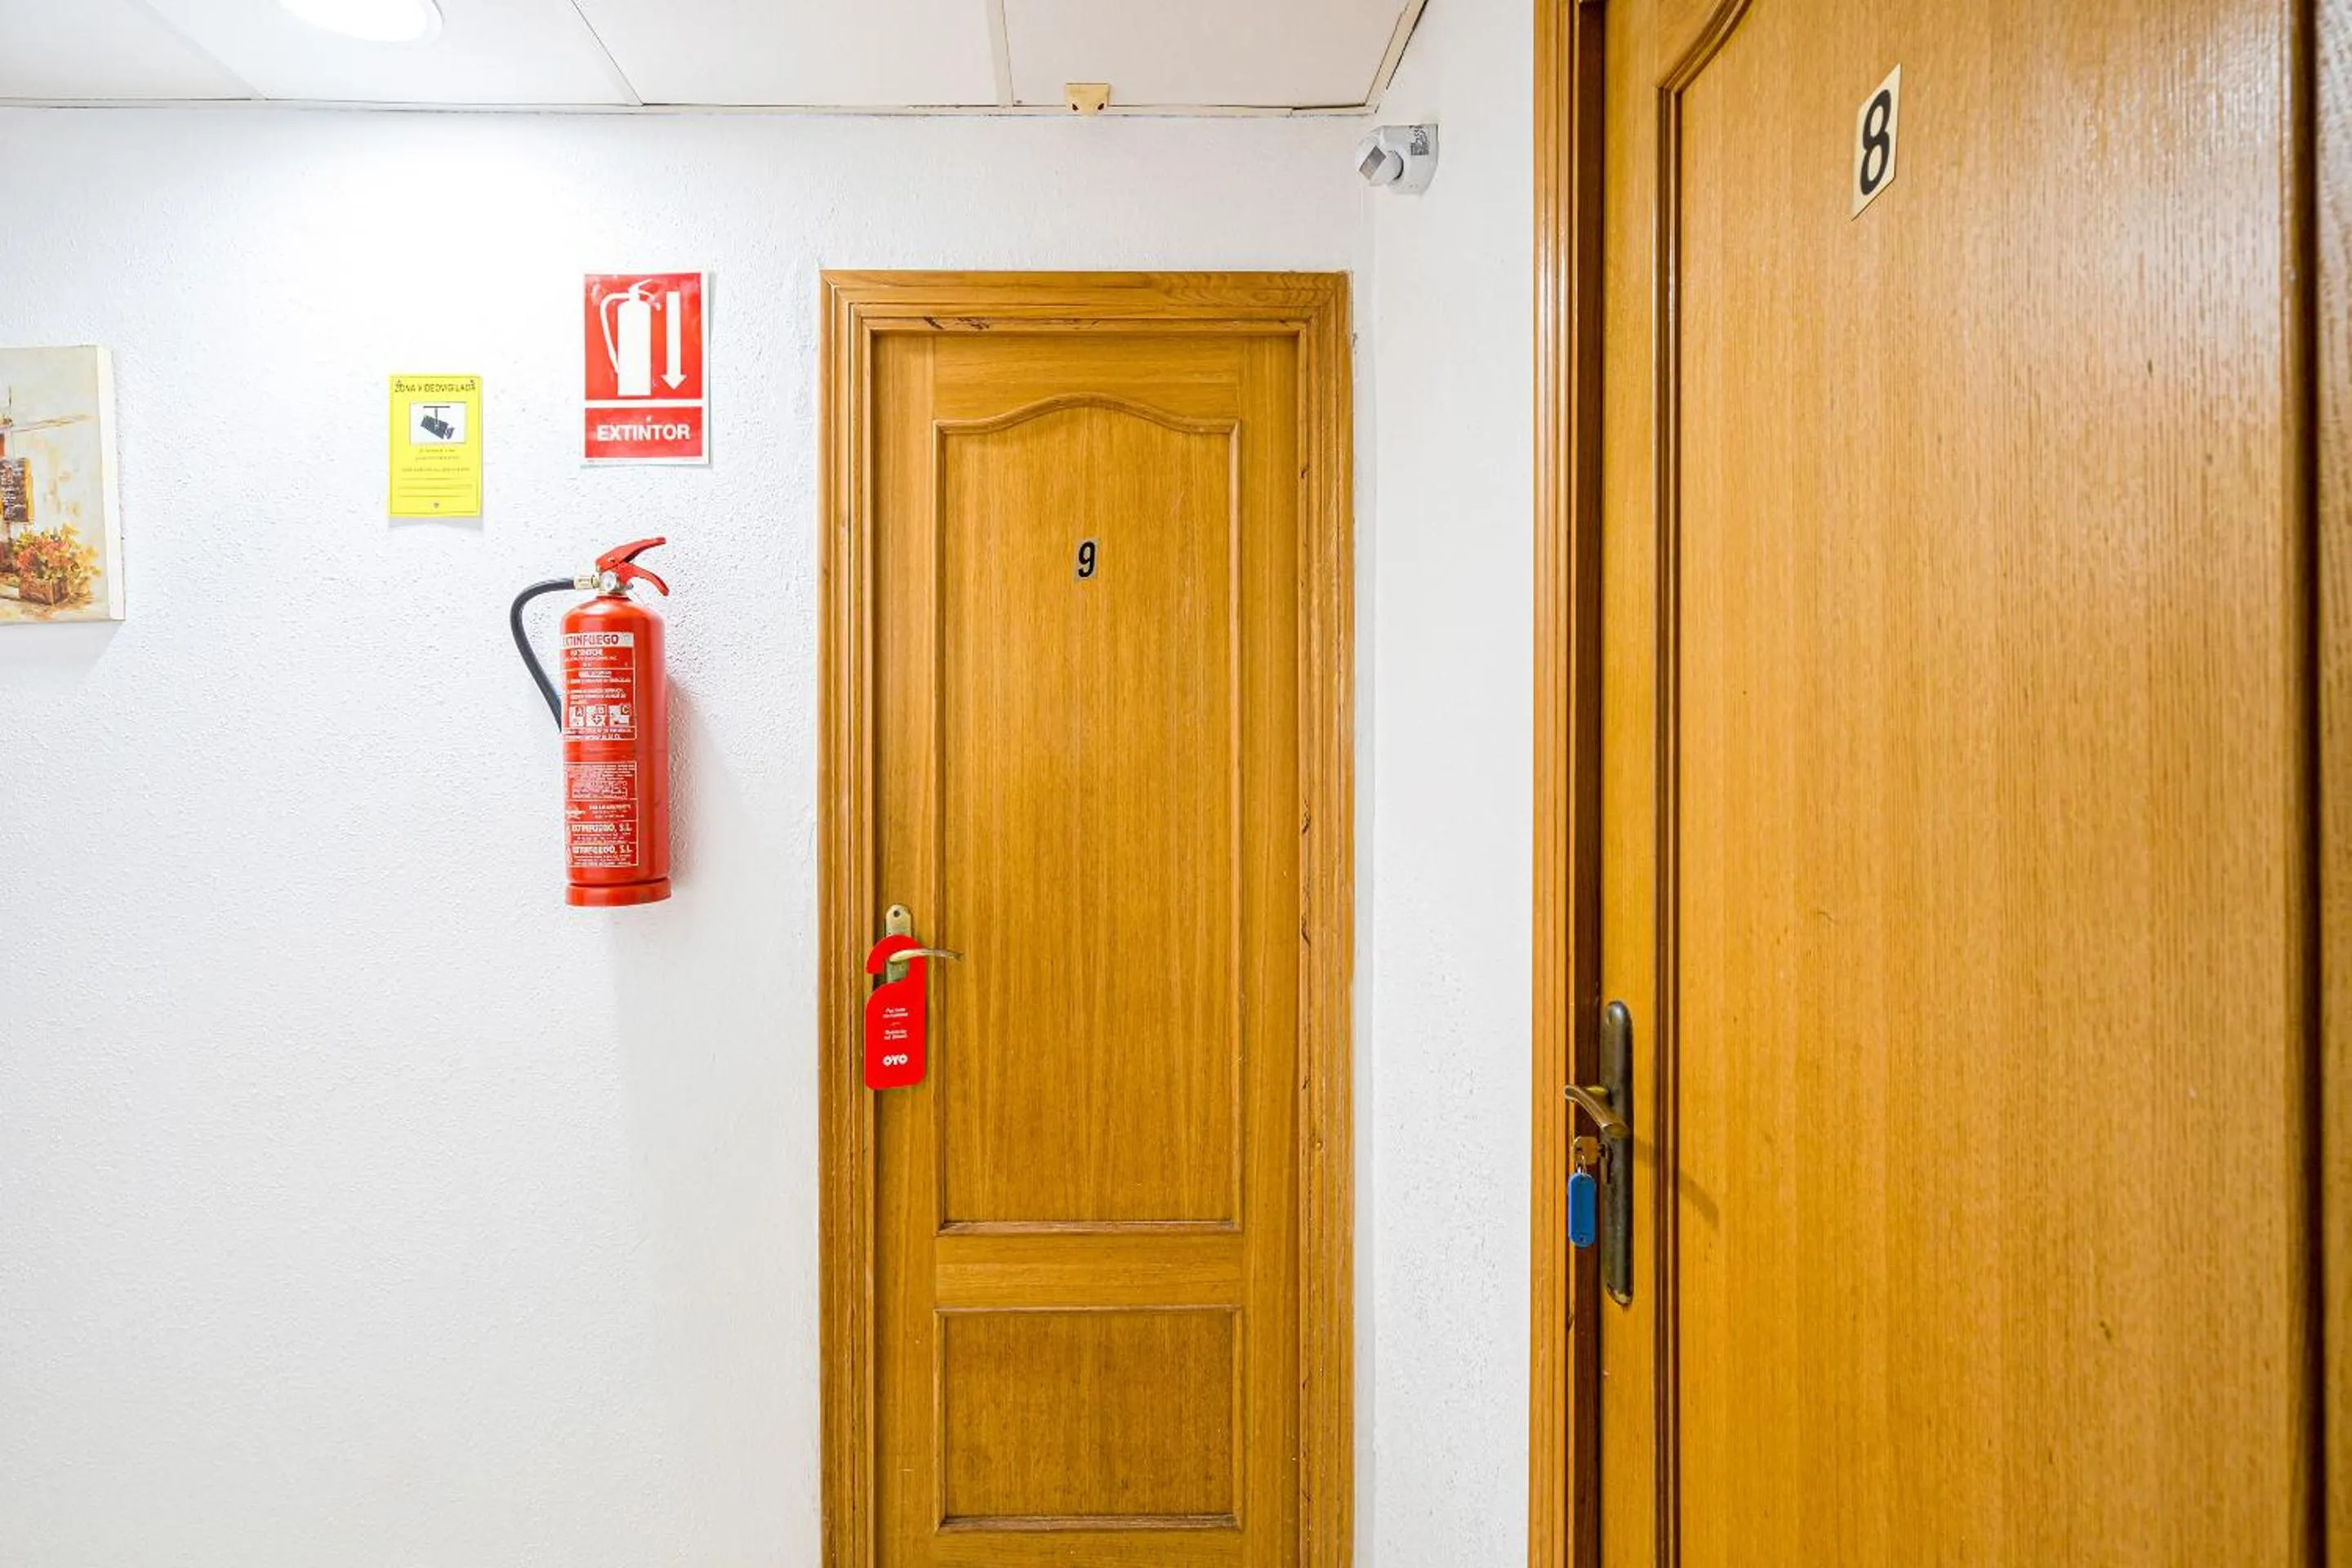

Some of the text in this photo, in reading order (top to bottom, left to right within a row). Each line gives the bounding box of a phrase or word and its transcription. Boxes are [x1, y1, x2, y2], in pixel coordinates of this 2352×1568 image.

[1860, 88, 1891, 196] 8
[417, 382, 476, 393] VDEOVIGILADA
[596, 424, 691, 442] EXTINTOR
[1078, 541, 1096, 578] 9
[882, 1054, 908, 1067] OYO
